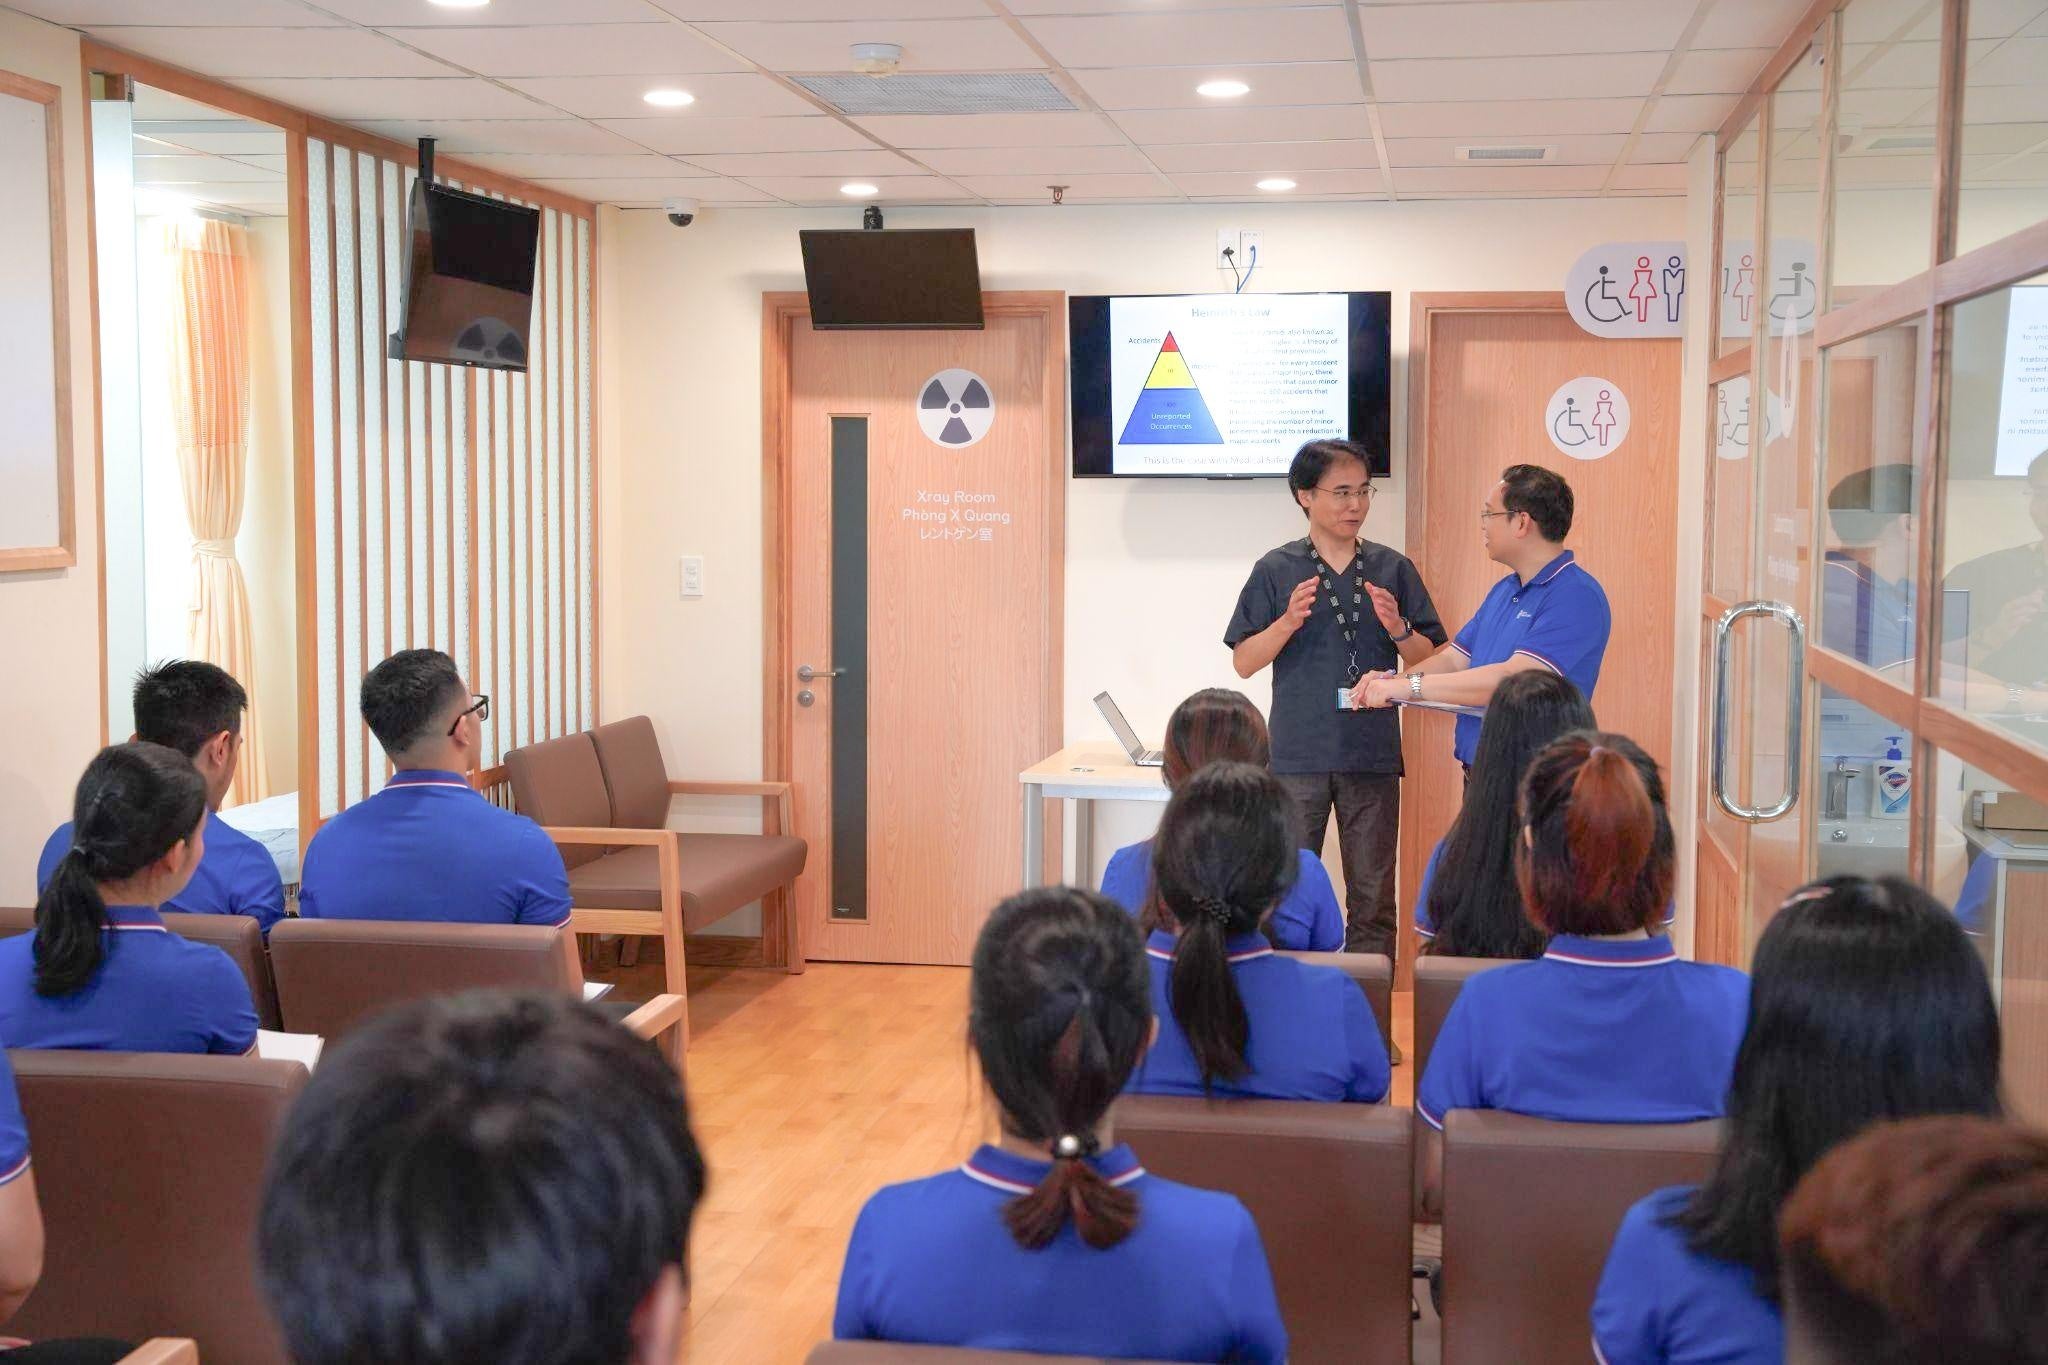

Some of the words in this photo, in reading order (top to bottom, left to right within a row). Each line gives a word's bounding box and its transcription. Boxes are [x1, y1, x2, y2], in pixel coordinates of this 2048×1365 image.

[1308, 337, 1330, 346] theory
[1151, 413, 1191, 421] Unreported
[1278, 417, 1305, 425] number
[1306, 417, 1313, 425] of
[1314, 417, 1334, 425] minor
[1150, 423, 1192, 431] Occurrences
[1302, 427, 1334, 435] reduction
[1335, 427, 1343, 435] in
[1143, 455, 1160, 465] This
[916, 489, 950, 505] Xray
[954, 490, 996, 503] Room
[902, 508, 947, 524] Phòng
[949, 509, 961, 521] X
[963, 508, 1010, 524] Quang
[920, 526, 993, 541] レントゲン室
